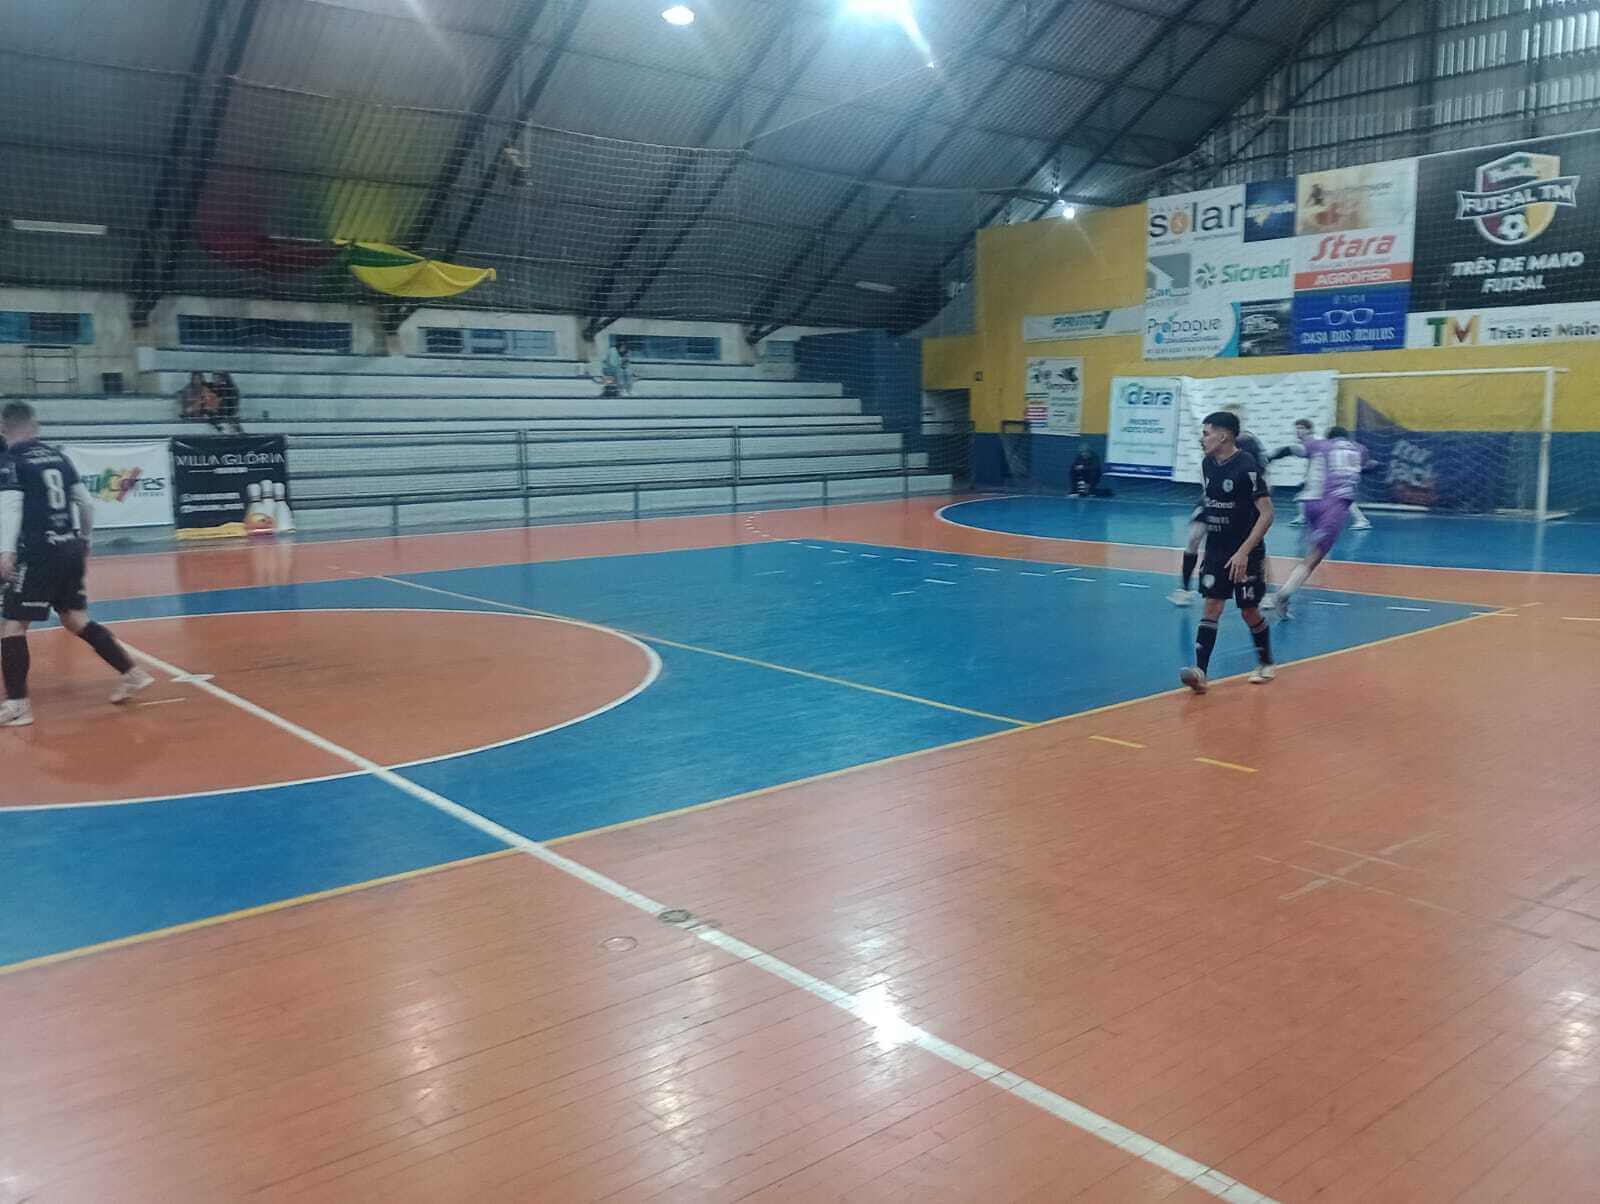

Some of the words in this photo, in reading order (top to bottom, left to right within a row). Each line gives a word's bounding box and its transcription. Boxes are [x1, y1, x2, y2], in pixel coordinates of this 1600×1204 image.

[1465, 188, 1537, 214] FUTSAL
[1538, 184, 1574, 201] TM
[1149, 201, 1243, 238] solar
[1310, 233, 1396, 261] Stara
[1221, 258, 1291, 284] Sicredi
[1451, 256, 1497, 276] TRÊS
[1497, 256, 1527, 272] DE
[1526, 251, 1585, 271] MAIO
[1481, 274, 1546, 294] FUTSAL
[1301, 331, 1329, 345] CASA
[1330, 329, 1352, 343] DOS
[1427, 315, 1481, 347] TM
[1530, 324, 1551, 338] de
[175, 454, 221, 467] VILLA
[42, 468, 66, 510] 8
[1242, 585, 1256, 599] 14
